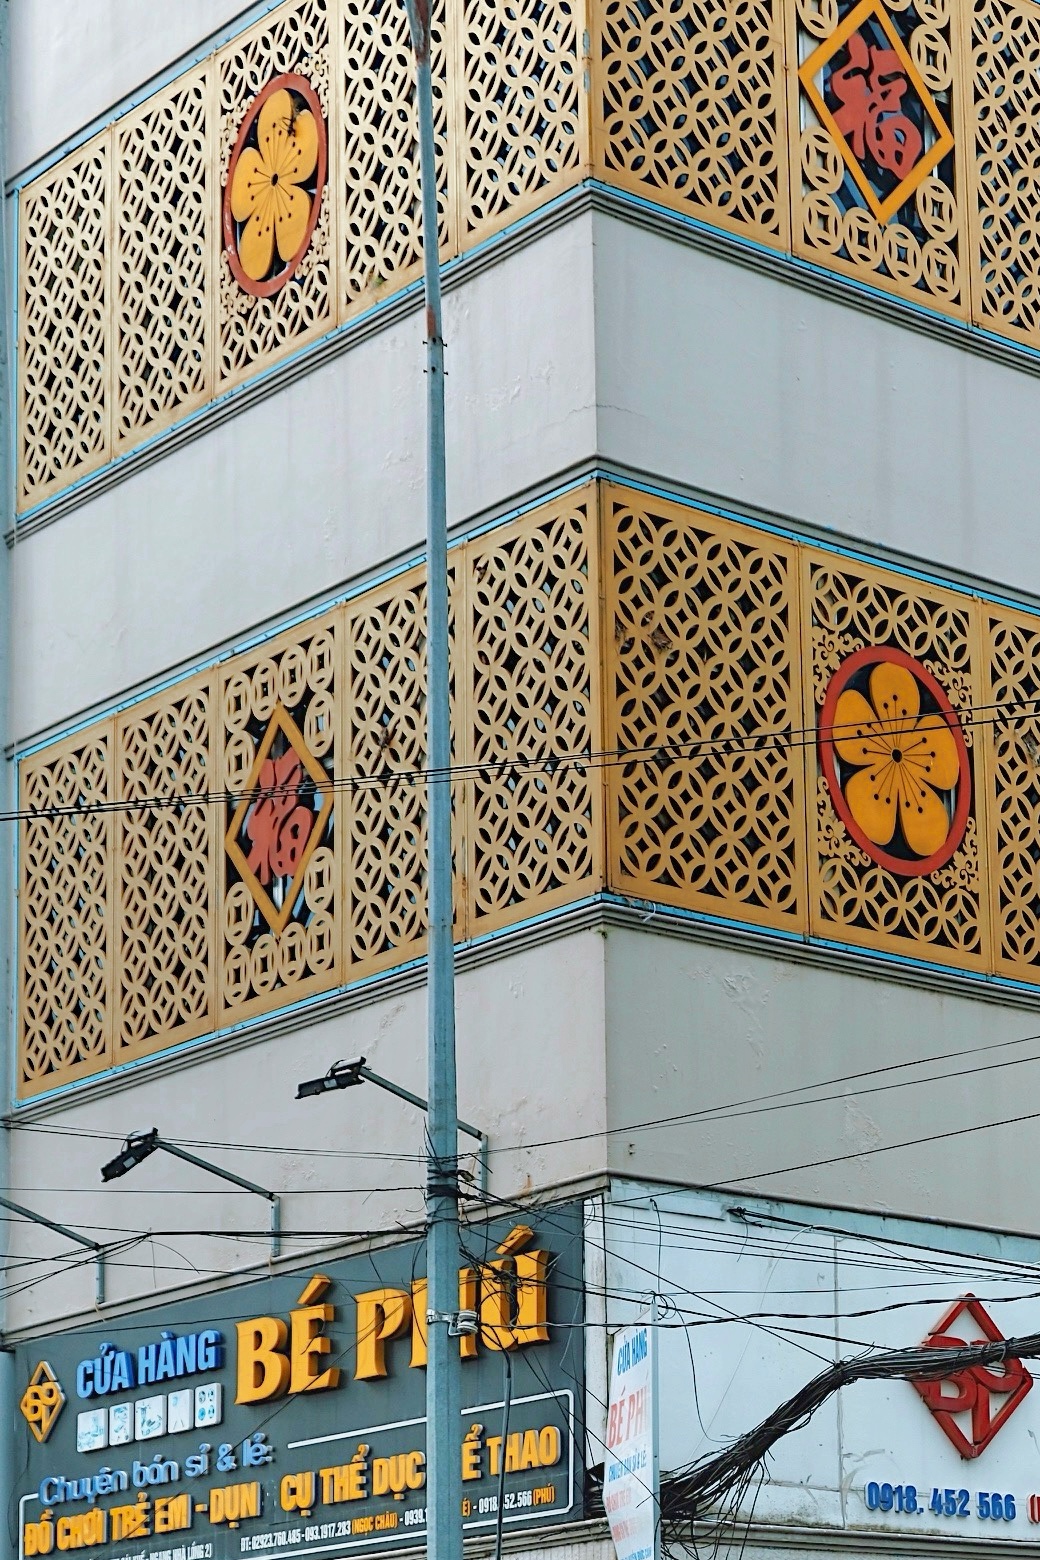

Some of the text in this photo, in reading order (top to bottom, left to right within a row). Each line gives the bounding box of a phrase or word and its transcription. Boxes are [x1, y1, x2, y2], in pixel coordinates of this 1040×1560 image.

[76, 1330, 224, 1399] CỬA HÀNG
[234, 1273, 341, 1405] BÉ
[608, 1385, 625, 1450] BÉ
[39, 1466, 130, 1506] Chuyên
[132, 1454, 181, 1489] bán
[216, 1443, 238, 1473] &
[110, 1491, 151, 1542] TRẺ
[154, 1494, 192, 1534] EM
[280, 1468, 315, 1517] CỤ
[320, 1444, 369, 1506] THỂ
[372, 1450, 427, 1501] DỤC
[486, 1424, 562, 1478] THAO
[478, 1490, 532, 1514] 0918.52.566
[864, 1482, 925, 1515] 0918.
[928, 1487, 971, 1520] 452
[975, 1492, 1017, 1522] 566
